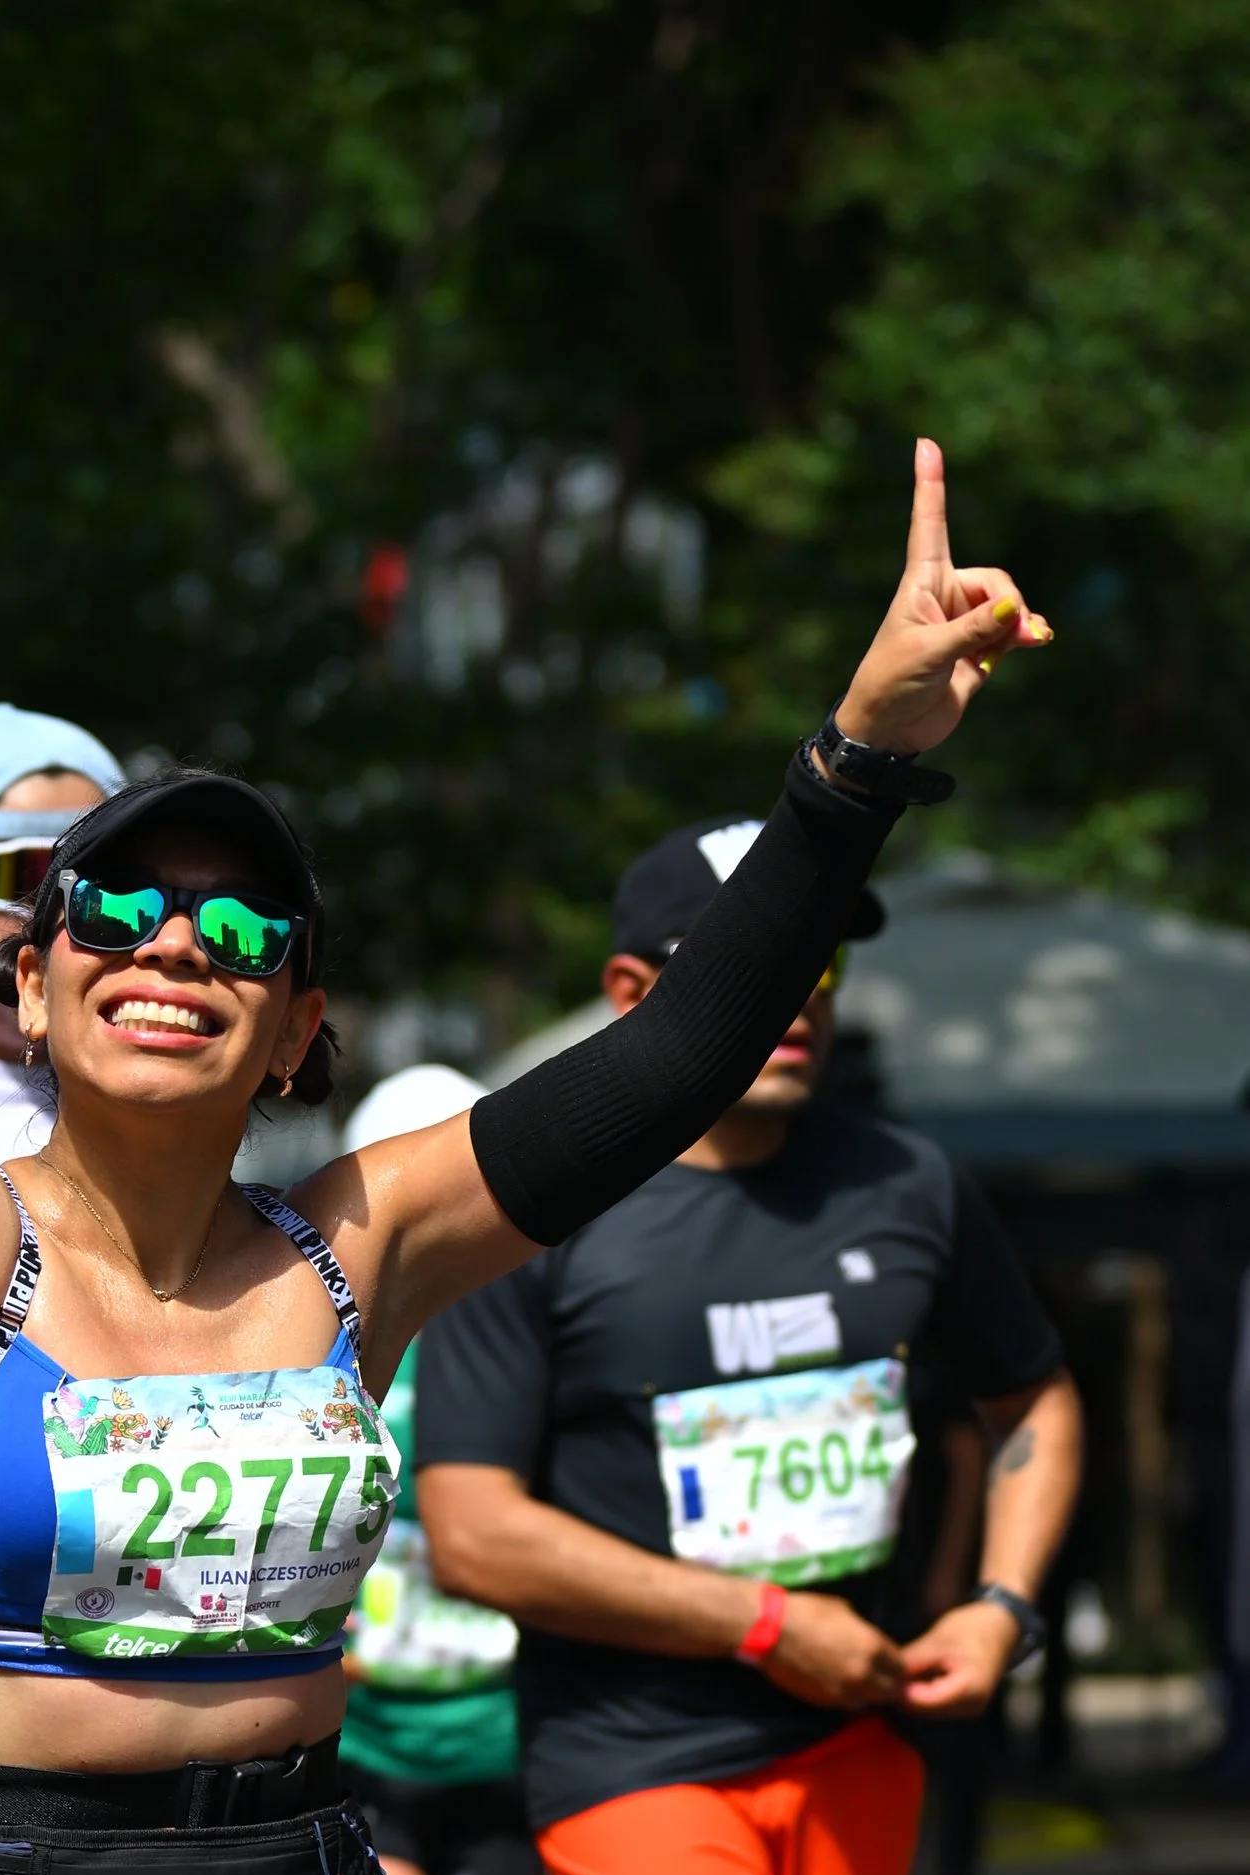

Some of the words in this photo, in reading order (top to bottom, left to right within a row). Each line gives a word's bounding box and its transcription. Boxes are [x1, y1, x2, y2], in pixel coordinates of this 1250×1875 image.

[301, 1230, 347, 1294] PINK
[219, 1403, 245, 1411] CIUDAD
[240, 1411, 263, 1421] telcel
[733, 1424, 892, 1512] 7604
[121, 1456, 393, 1560] 22775
